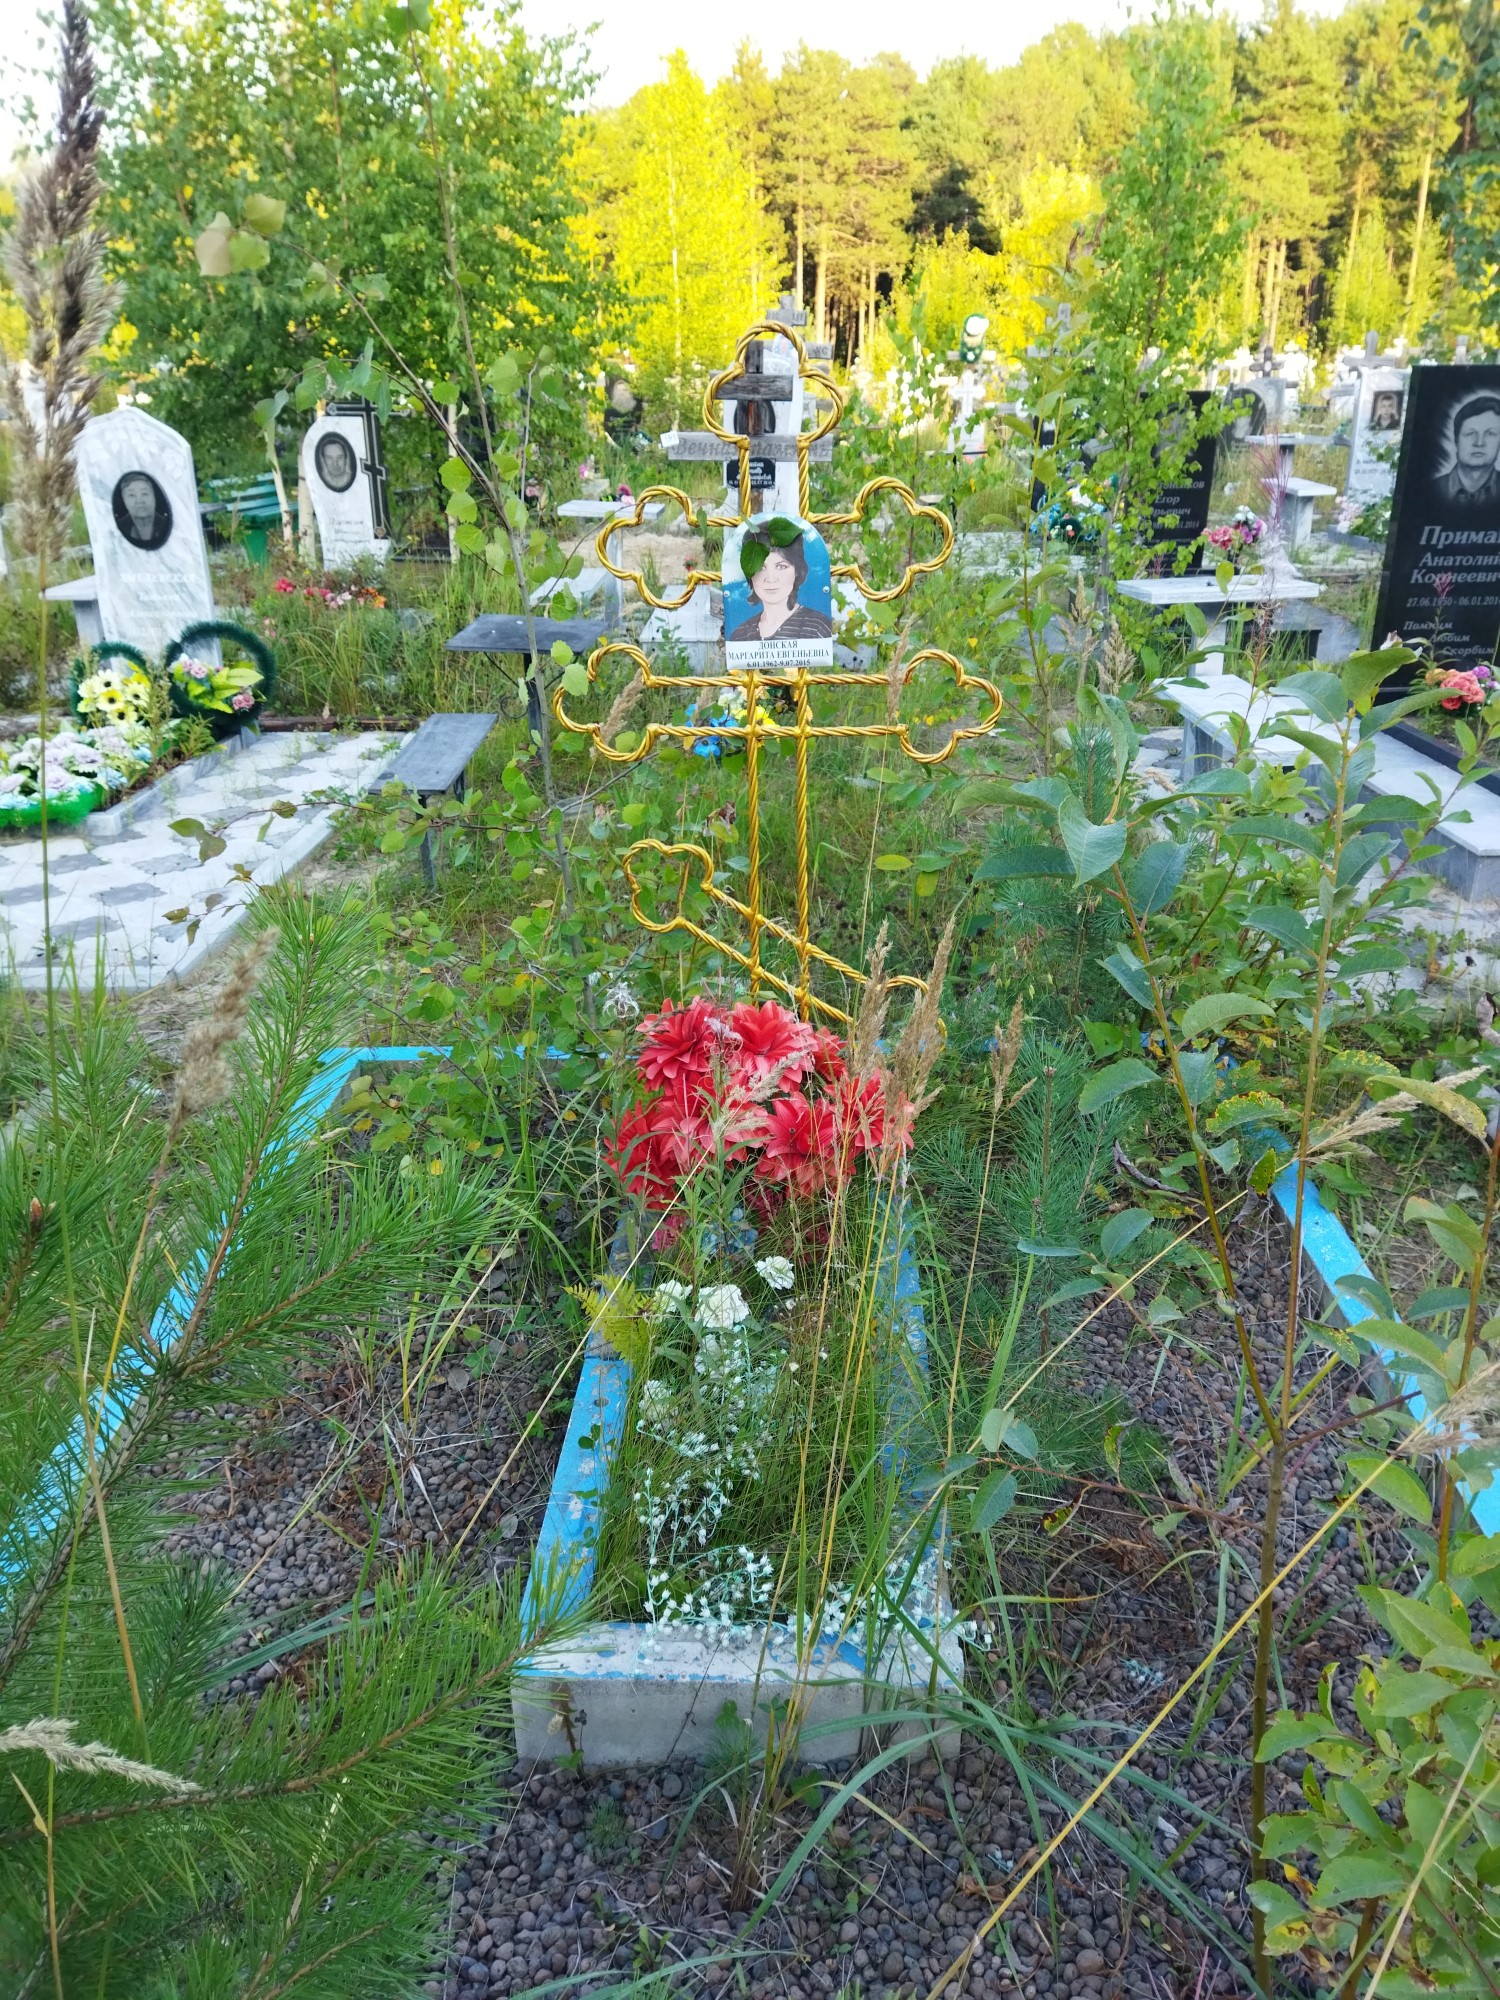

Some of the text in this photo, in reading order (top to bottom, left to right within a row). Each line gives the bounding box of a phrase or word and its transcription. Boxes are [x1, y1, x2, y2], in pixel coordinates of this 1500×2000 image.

[672, 438, 737, 455] Вечна
[1153, 508, 1192, 517] рьевич
[1419, 525, 1500, 549] Прима
[1410, 568, 1500, 586] Корнееви
[1458, 595, 1500, 606] 06.01.201
[759, 641, 798, 650] ДОНСКАЯ
[728, 649, 830, 660] МАРГАРИТА ЕВГЕНЬЕВНА
[746, 659, 811, 668] 6.01.1962-9.07.2015
